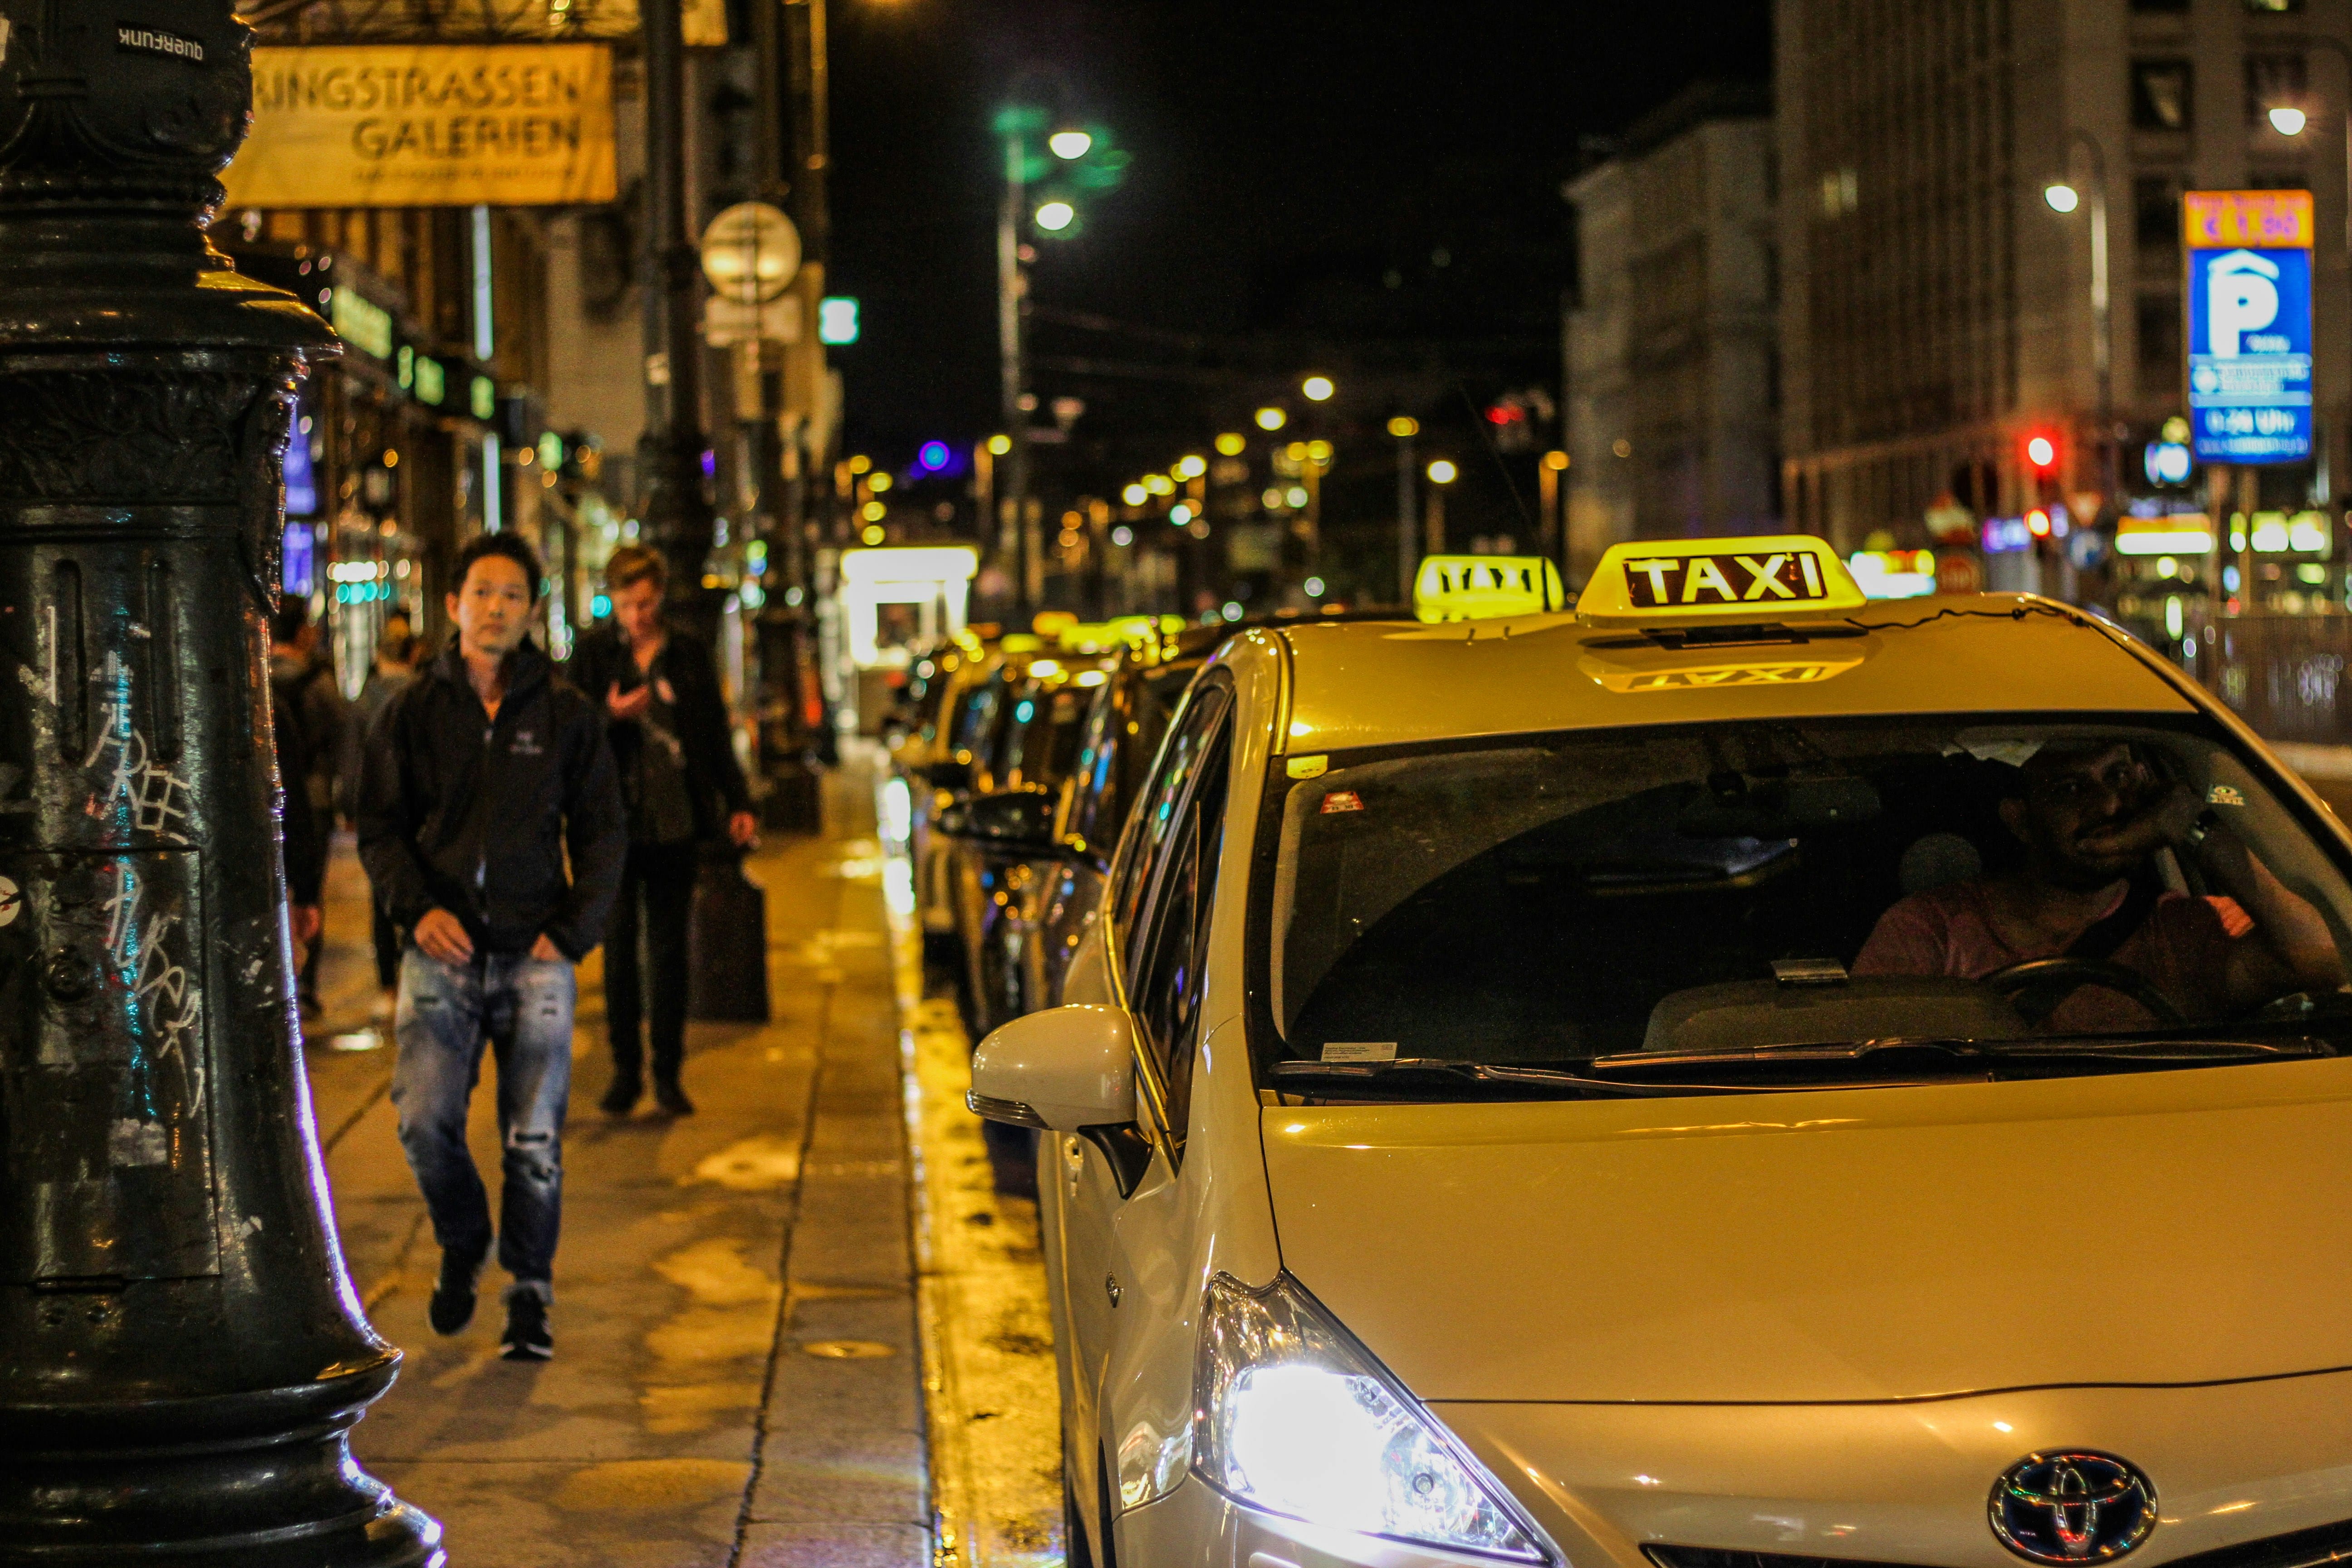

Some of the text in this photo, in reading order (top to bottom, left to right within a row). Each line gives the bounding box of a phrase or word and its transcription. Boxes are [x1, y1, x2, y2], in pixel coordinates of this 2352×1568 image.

[351, 114, 581, 159] GALERIEN
[2208, 272, 2279, 359] P
[1628, 552, 1823, 604] TAXI
